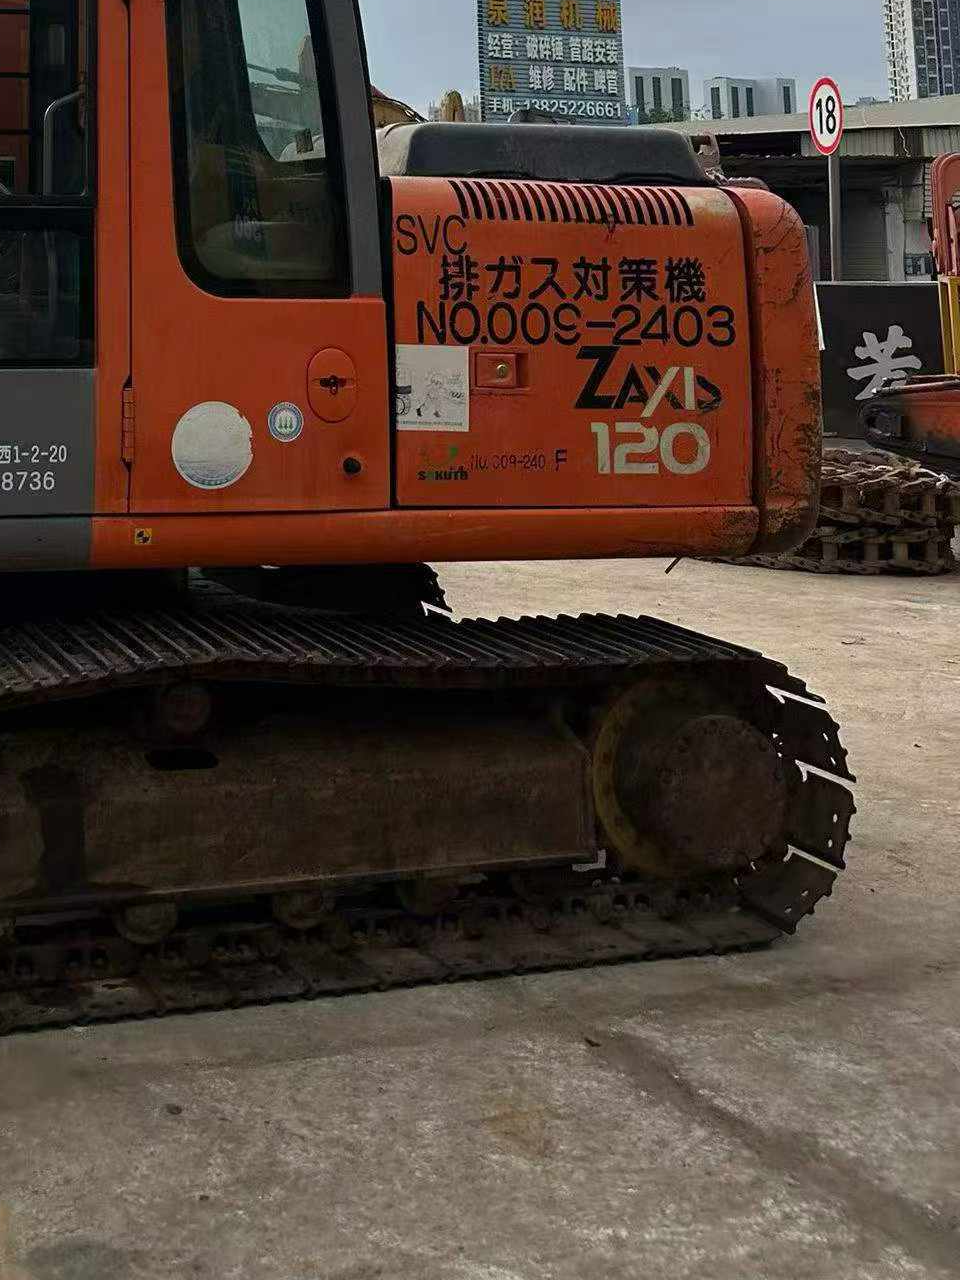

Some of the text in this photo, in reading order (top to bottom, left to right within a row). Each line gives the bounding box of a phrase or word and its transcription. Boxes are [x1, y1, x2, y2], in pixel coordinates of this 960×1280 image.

[528, 64, 556, 92] 维修
[563, 67, 589, 93] 配件
[815, 96, 837, 135] 18
[396, 213, 468, 256] SVC
[439, 255, 707, 303] 排ガス対策機
[590, 422, 711, 475] 120
